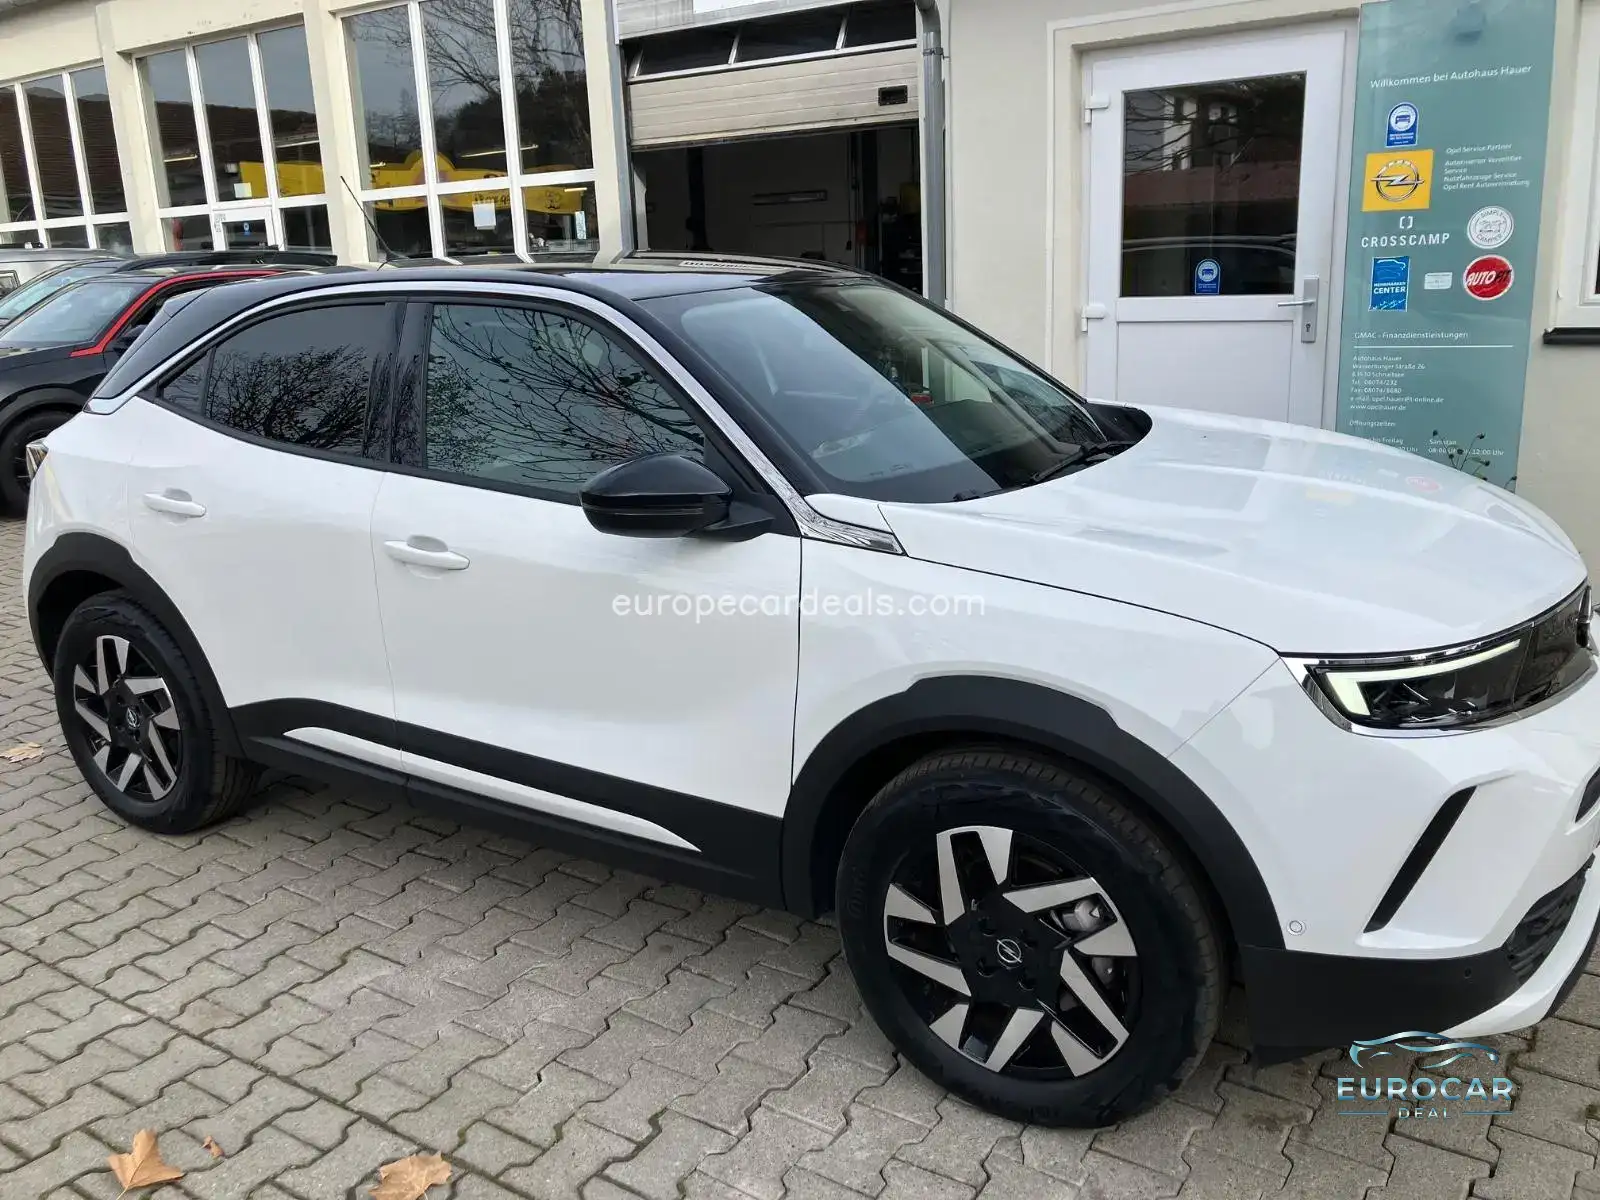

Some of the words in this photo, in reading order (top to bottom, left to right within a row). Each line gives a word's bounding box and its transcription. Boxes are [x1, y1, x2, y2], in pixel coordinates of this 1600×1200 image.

[1370, 76, 1431, 88] Willkommen
[1433, 73, 1449, 82] bei
[1450, 69, 1499, 80] Autohaus
[1500, 65, 1532, 75] Hauer
[1361, 232, 1450, 248] CROSSCAMP
[1373, 286, 1406, 294] CENTER
[1354, 331, 1377, 339] GMAC
